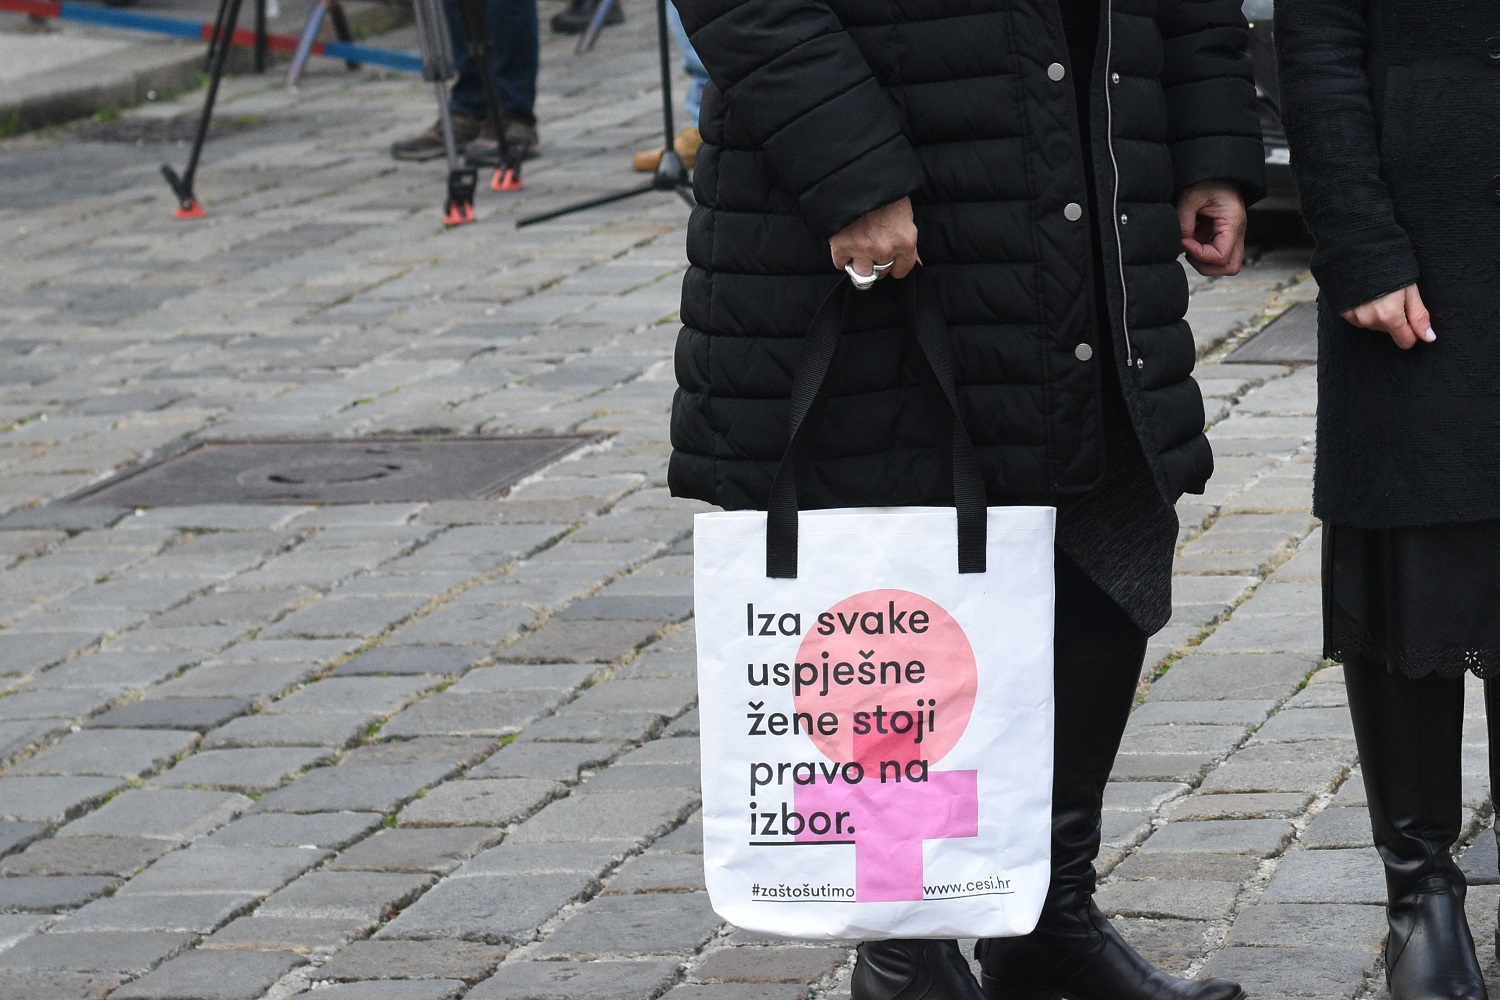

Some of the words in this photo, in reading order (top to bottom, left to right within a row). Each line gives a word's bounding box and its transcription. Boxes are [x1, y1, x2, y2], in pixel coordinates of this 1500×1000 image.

[747, 603, 801, 636] Iza
[817, 600, 930, 636] svake
[747, 649, 925, 697] uspješne
[747, 700, 839, 736] žene
[853, 698, 936, 744] stoji
[750, 762, 865, 797] pravo
[880, 759, 929, 784] na
[750, 802, 856, 836] izbor.
[751, 883, 855, 898] #zaštošutimo
[923, 876, 1012, 896] www.cesi.hr
